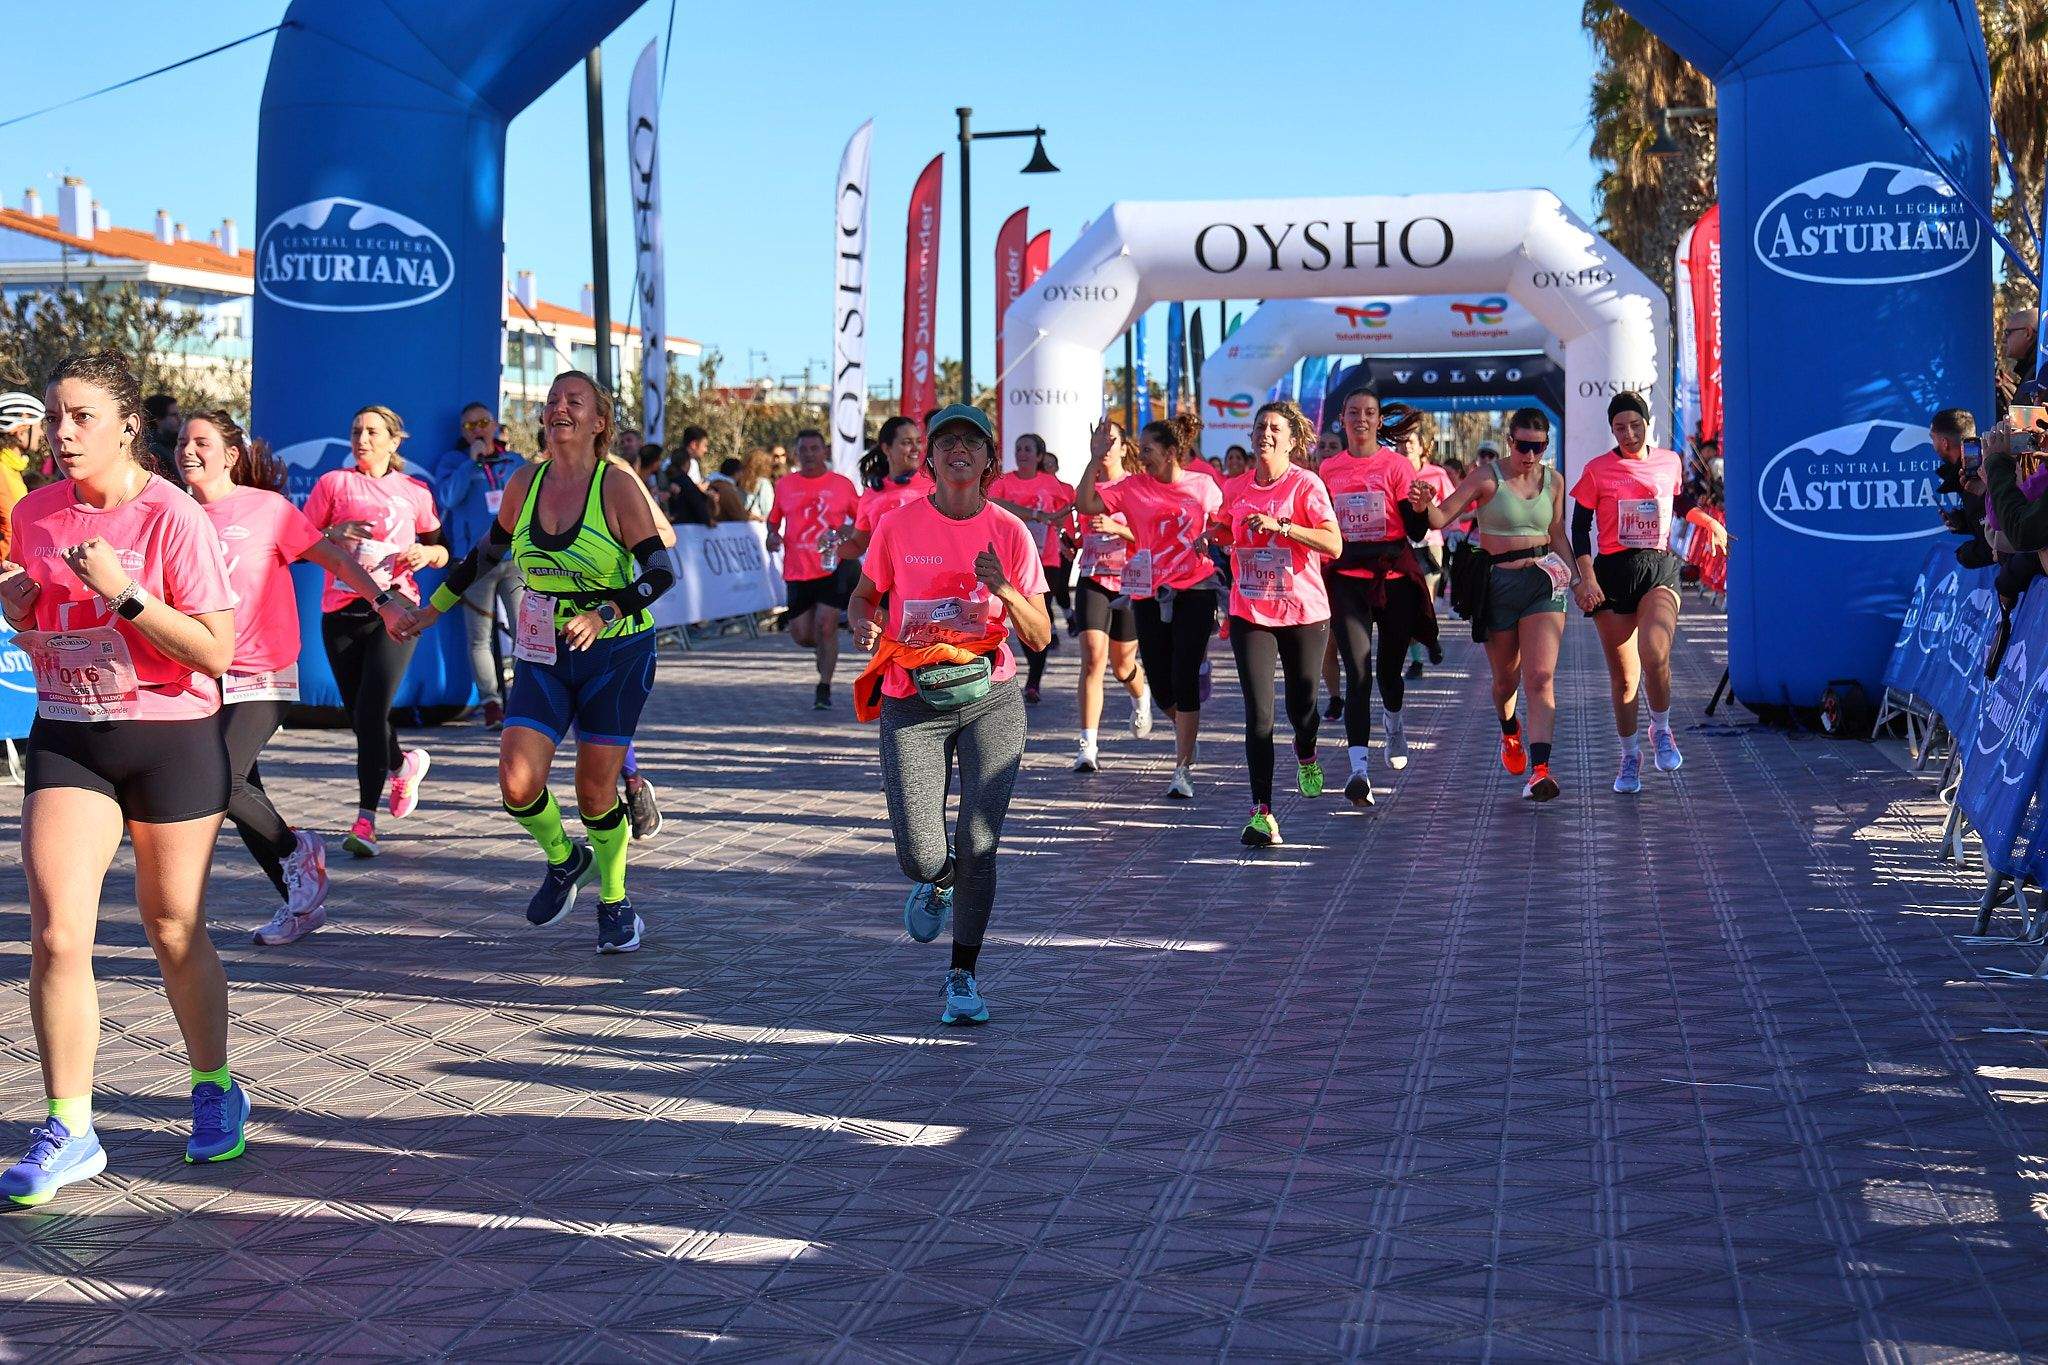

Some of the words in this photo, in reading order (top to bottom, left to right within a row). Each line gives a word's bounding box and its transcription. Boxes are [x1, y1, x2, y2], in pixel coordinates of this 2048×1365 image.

[1803, 204, 1887, 220] CENTRAL
[1894, 202, 1966, 215] LECHERA
[1768, 212, 1971, 259] ASTURIANA
[282, 236, 348, 249] CENTRAL
[354, 238, 432, 254] LECHERA
[1194, 216, 1454, 274] OYSHO
[263, 240, 439, 288] ASTURIANA
[1533, 268, 1613, 288] OYSHO
[1043, 285, 1118, 301] OYSHO
[838, 182, 864, 443] OYSHO
[1393, 368, 1523, 385] VOLVO
[1009, 388, 1078, 406] OYSHO
[1807, 461, 1890, 476] CENTRAL
[1898, 459, 1942, 472] LECH
[1348, 513, 1369, 523] 016
[1637, 520, 1658, 530] 016
[34, 546, 64, 558] OYSH
[905, 555, 943, 565] OYSHO
[1256, 569, 1276, 580] 016
[60, 667, 100, 684] 016
[48, 705, 78, 716] OYSHO
